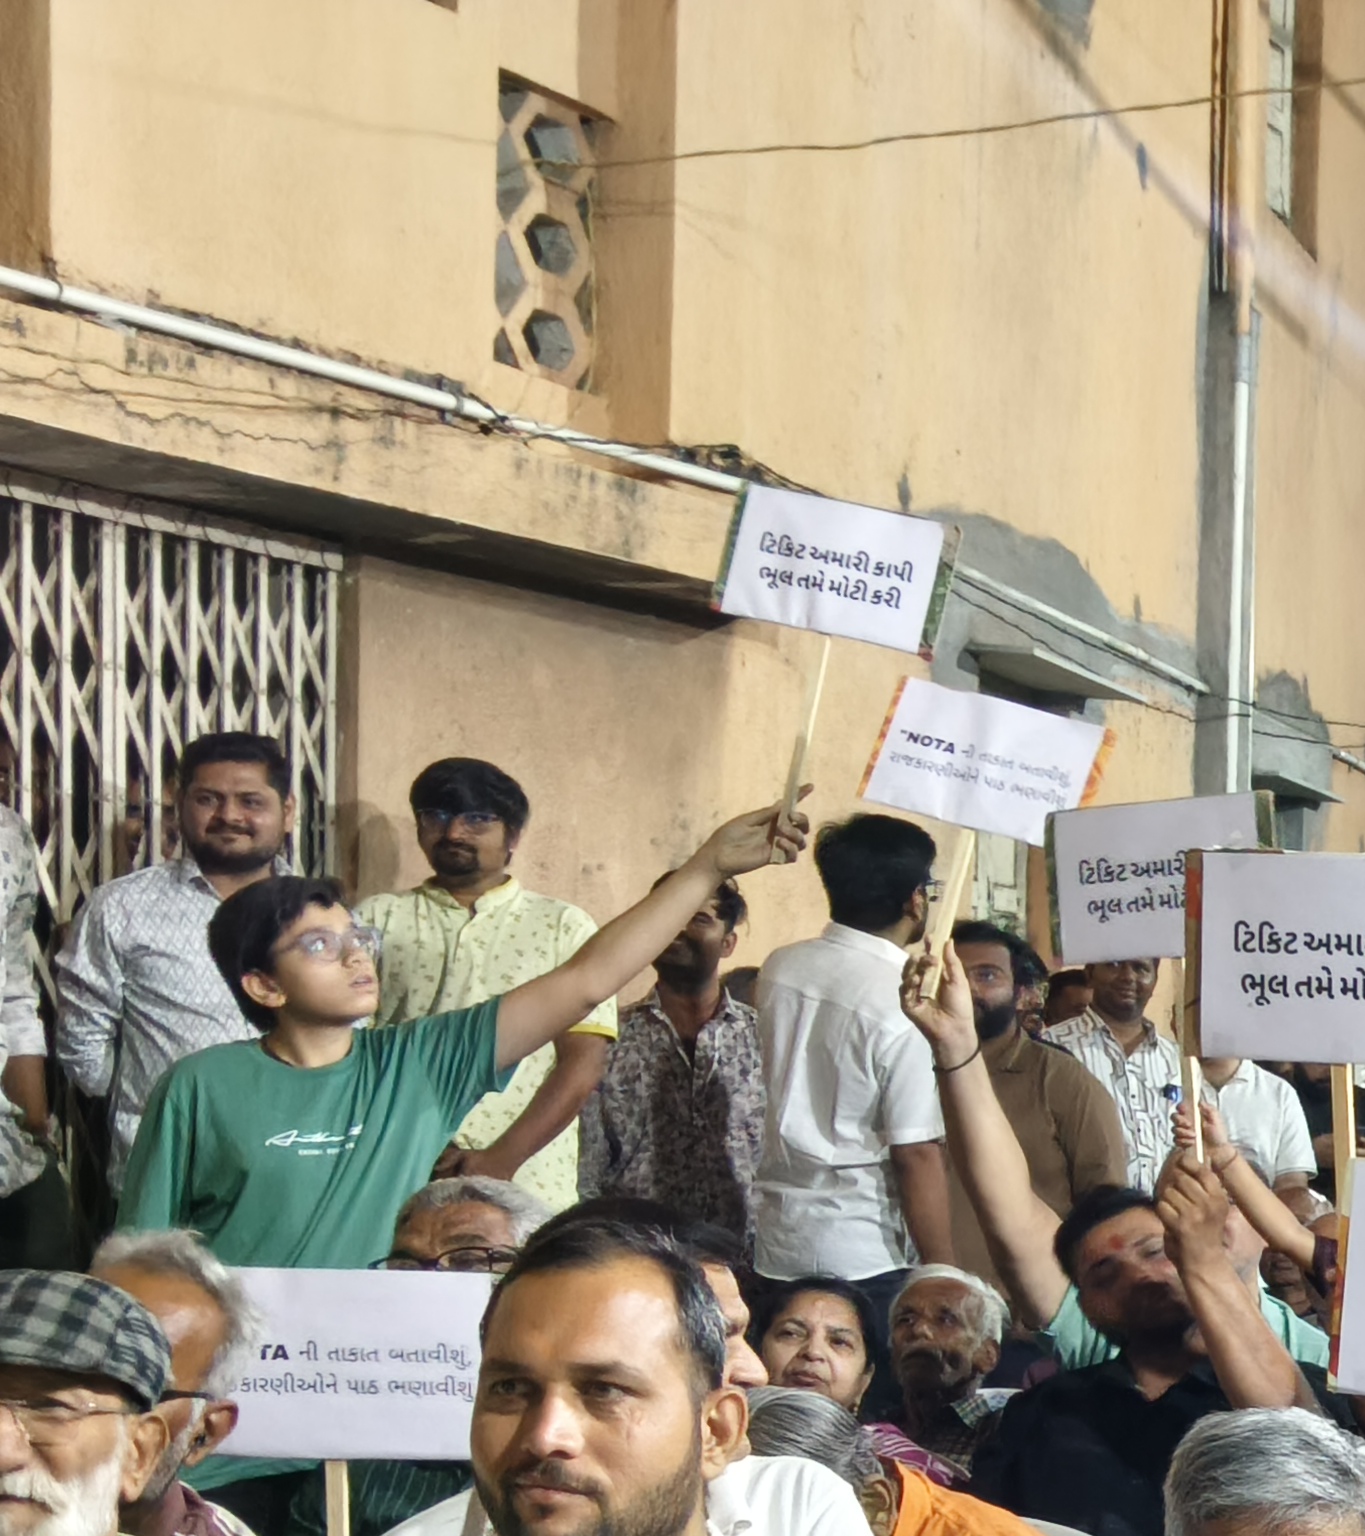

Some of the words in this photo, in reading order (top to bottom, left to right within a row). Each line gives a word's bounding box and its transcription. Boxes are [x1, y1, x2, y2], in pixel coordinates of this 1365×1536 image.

[900, 729, 955, 754] "NOTA
[1234, 920, 1298, 955] ટિકિટ
[1241, 973, 1290, 1006] ભૂલ
[1295, 965, 1335, 1000] તમે
